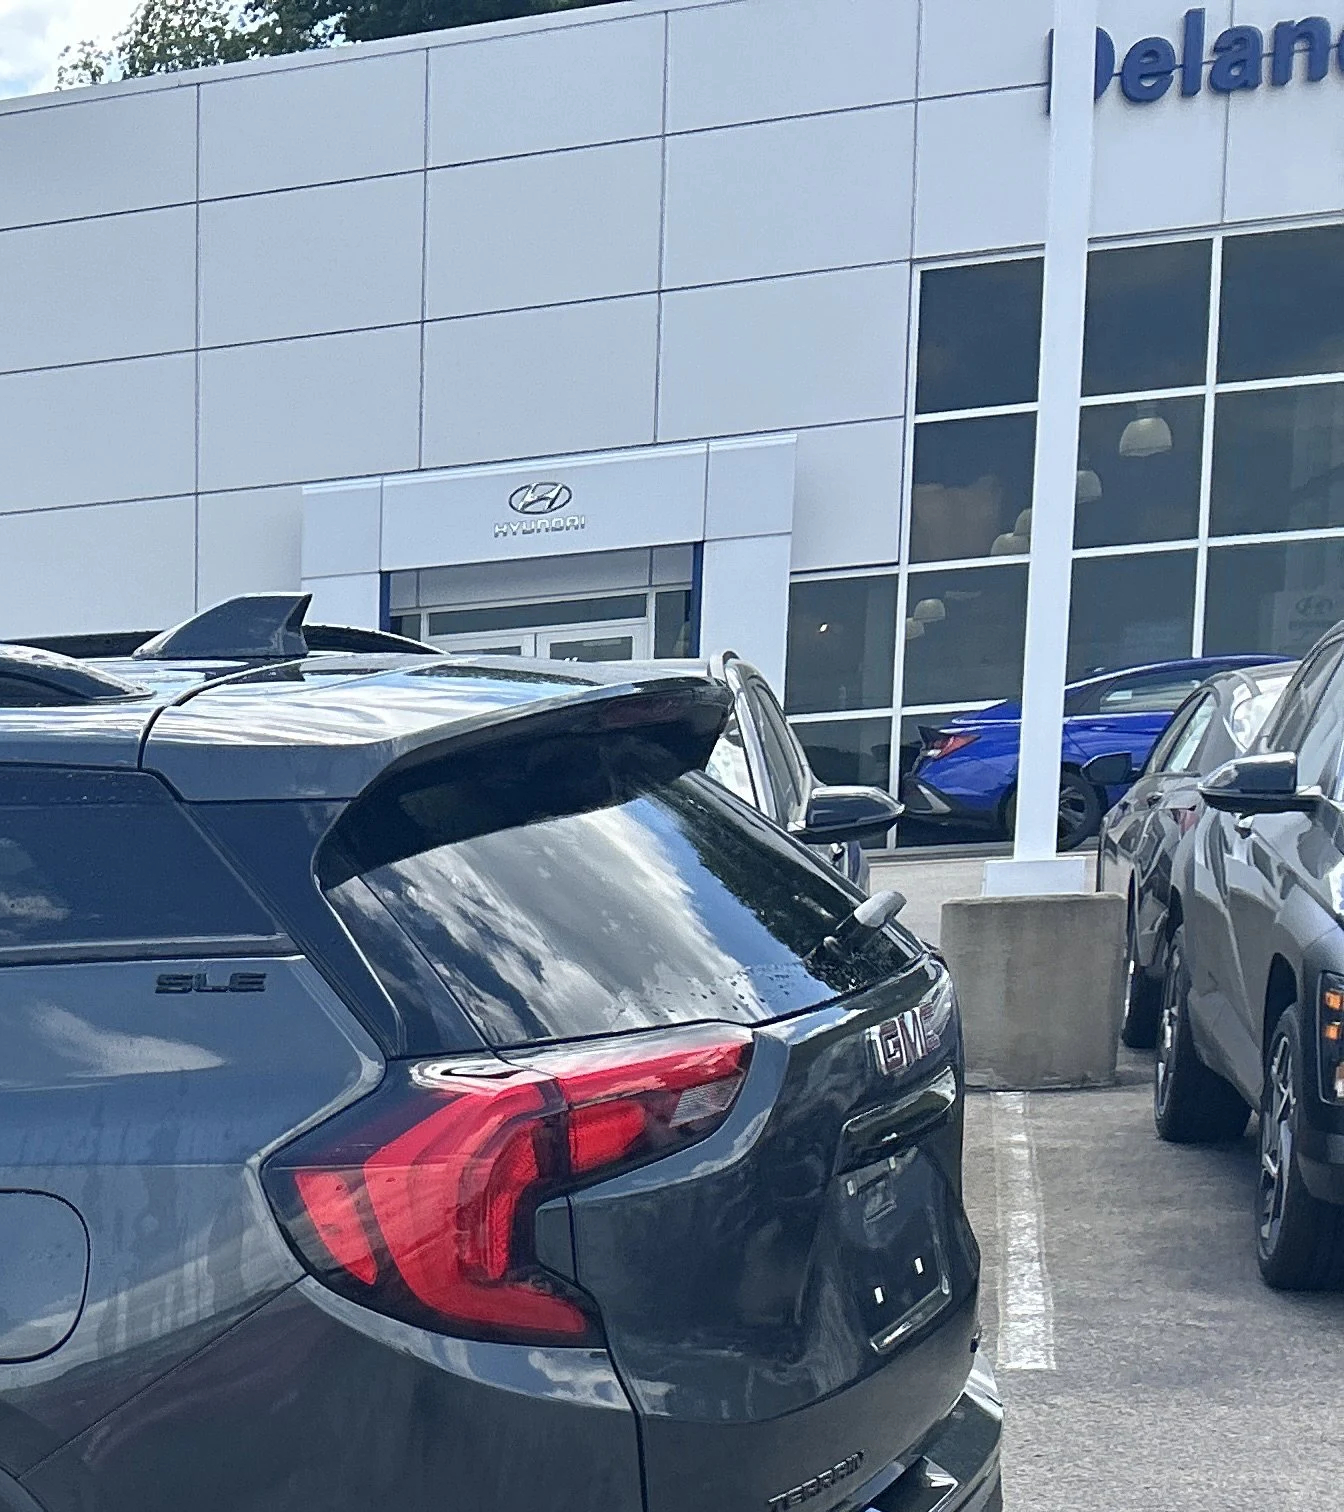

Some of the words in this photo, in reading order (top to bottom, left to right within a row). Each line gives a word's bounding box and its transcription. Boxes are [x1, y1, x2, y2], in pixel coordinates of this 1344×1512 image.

[1045, 8, 1344, 115] elan
[493, 515, 586, 538] HYUNDAI
[154, 972, 268, 994] SLE
